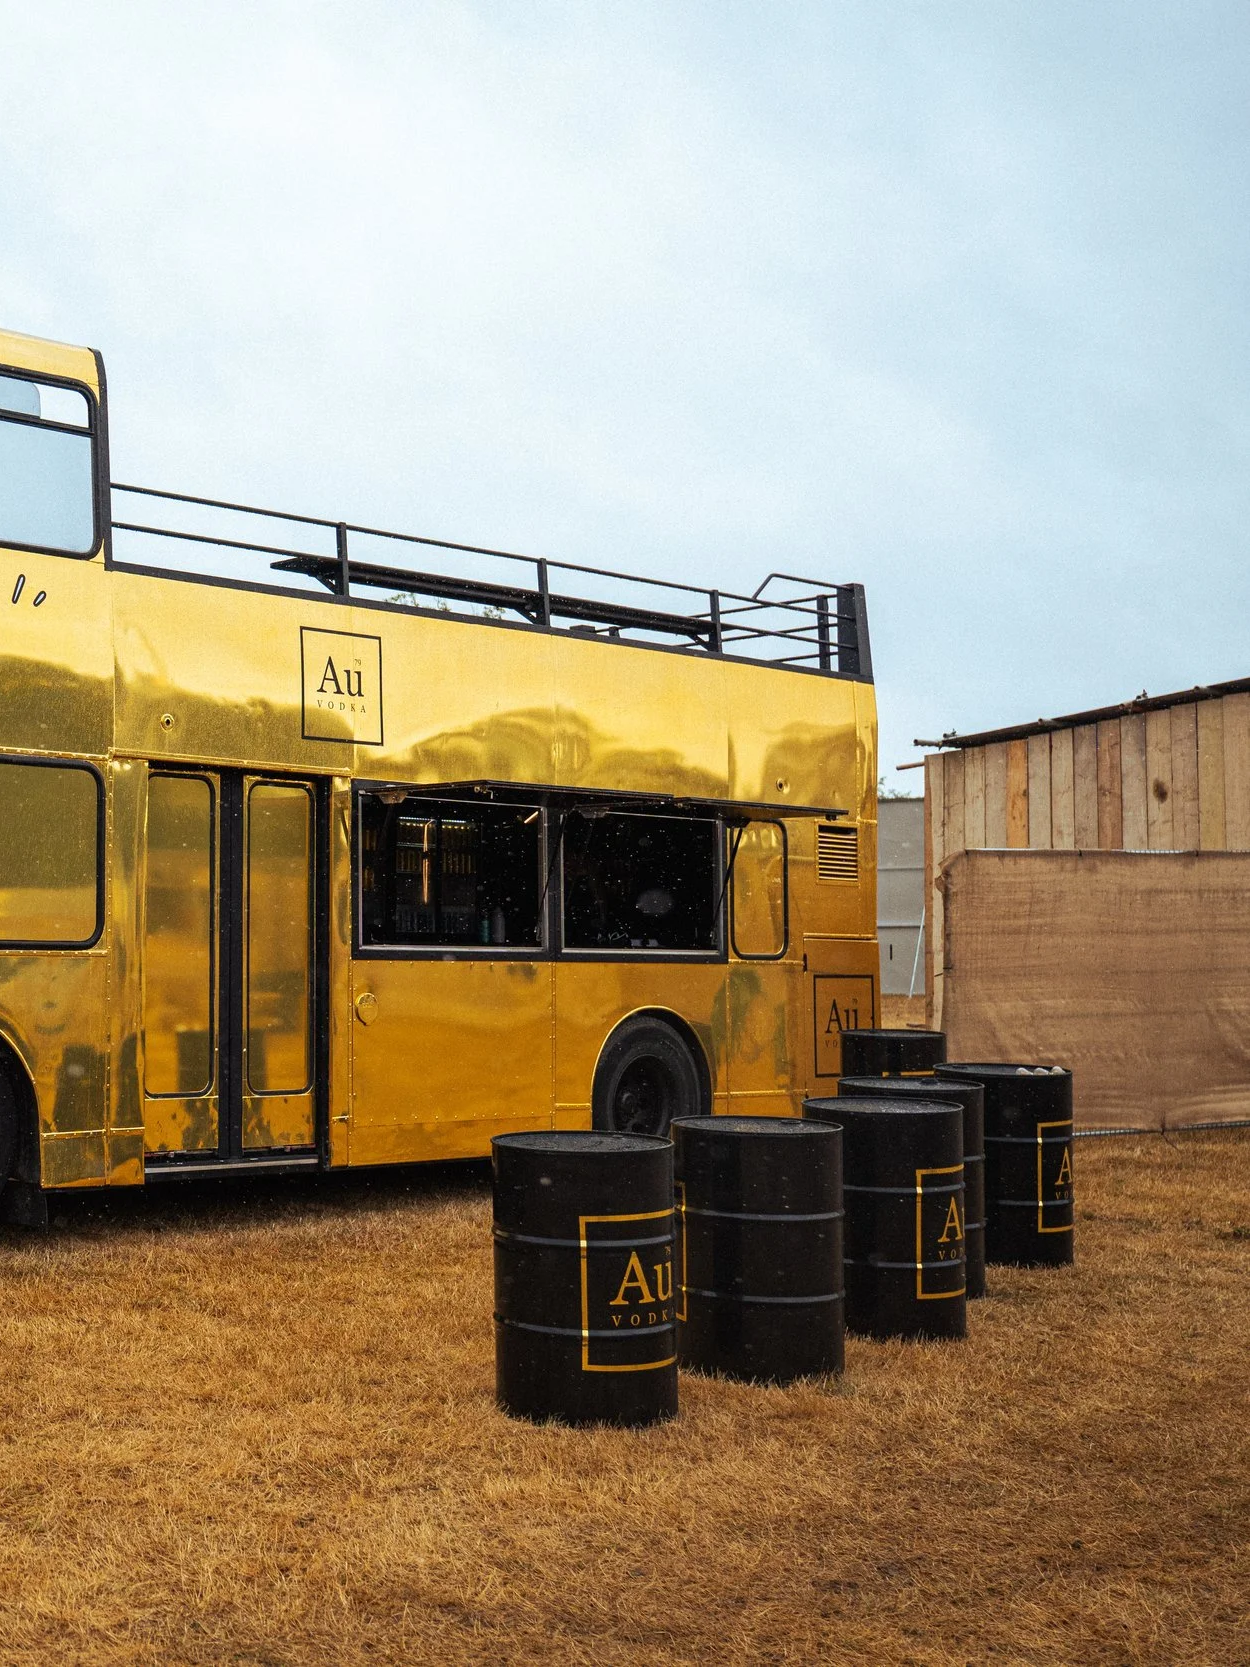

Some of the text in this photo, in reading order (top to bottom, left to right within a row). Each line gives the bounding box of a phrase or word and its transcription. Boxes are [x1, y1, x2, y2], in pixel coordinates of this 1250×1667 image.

[317, 656, 364, 697] Au
[354, 659, 362, 667] 79
[317, 700, 367, 713] VODKA
[938, 1196, 965, 1242] A
[609, 1251, 673, 1305] Au
